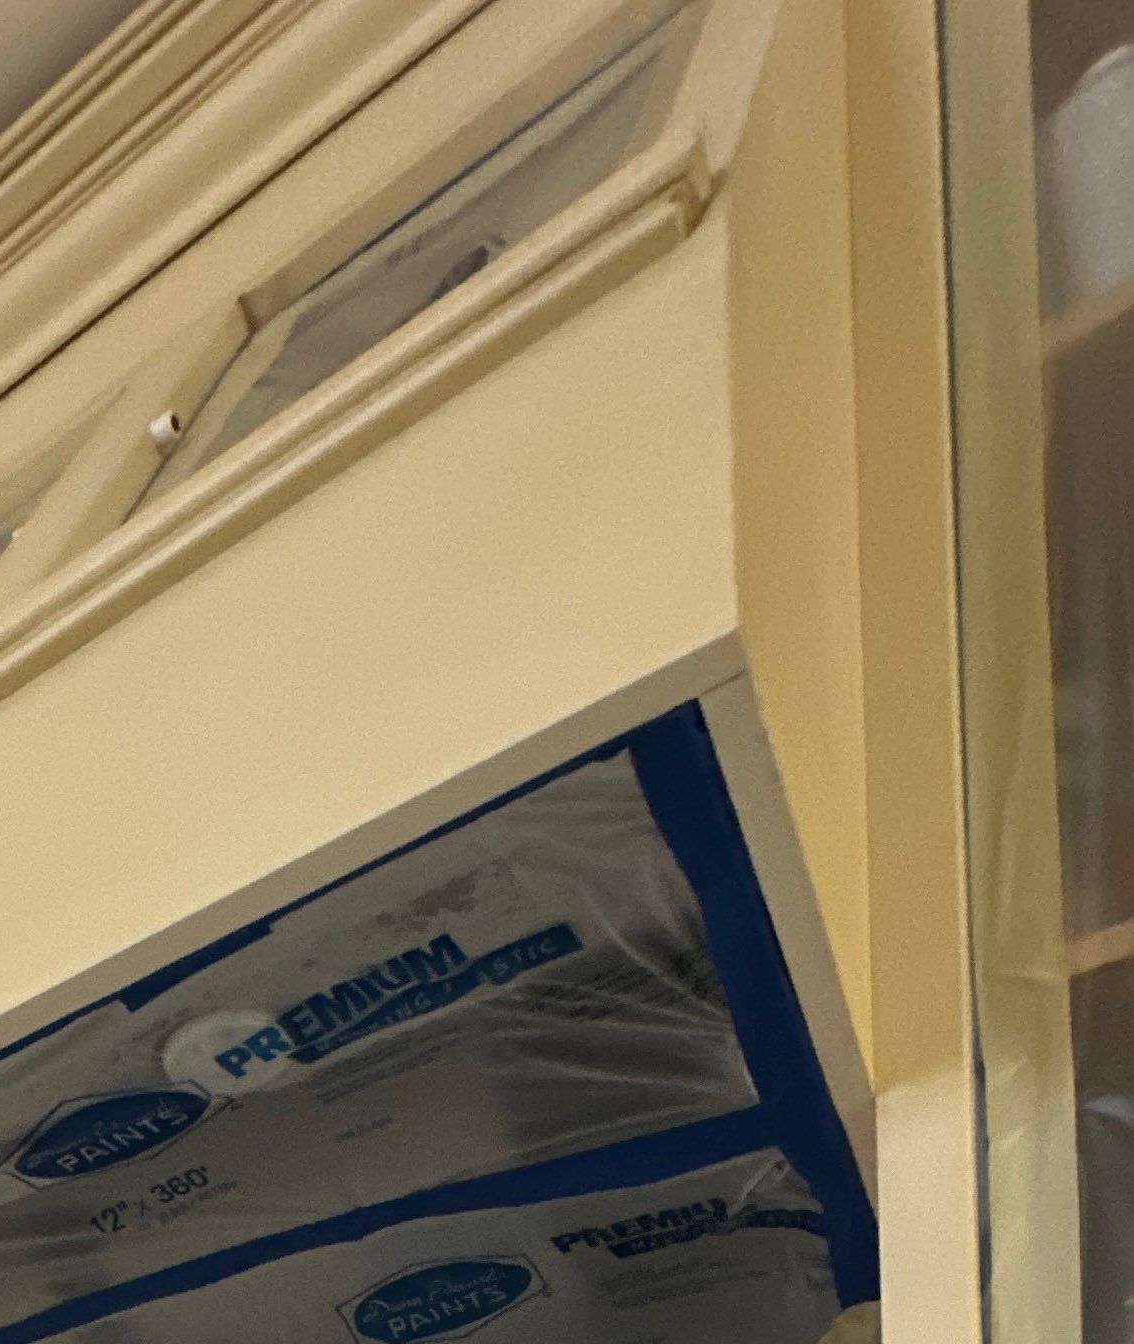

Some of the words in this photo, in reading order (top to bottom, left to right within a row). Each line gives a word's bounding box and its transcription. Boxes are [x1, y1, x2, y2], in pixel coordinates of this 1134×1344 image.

[215, 933, 468, 1078] PREMIUM
[56, 1106, 189, 1172] PAINTS
[387, 1285, 507, 1339] PAINTS
